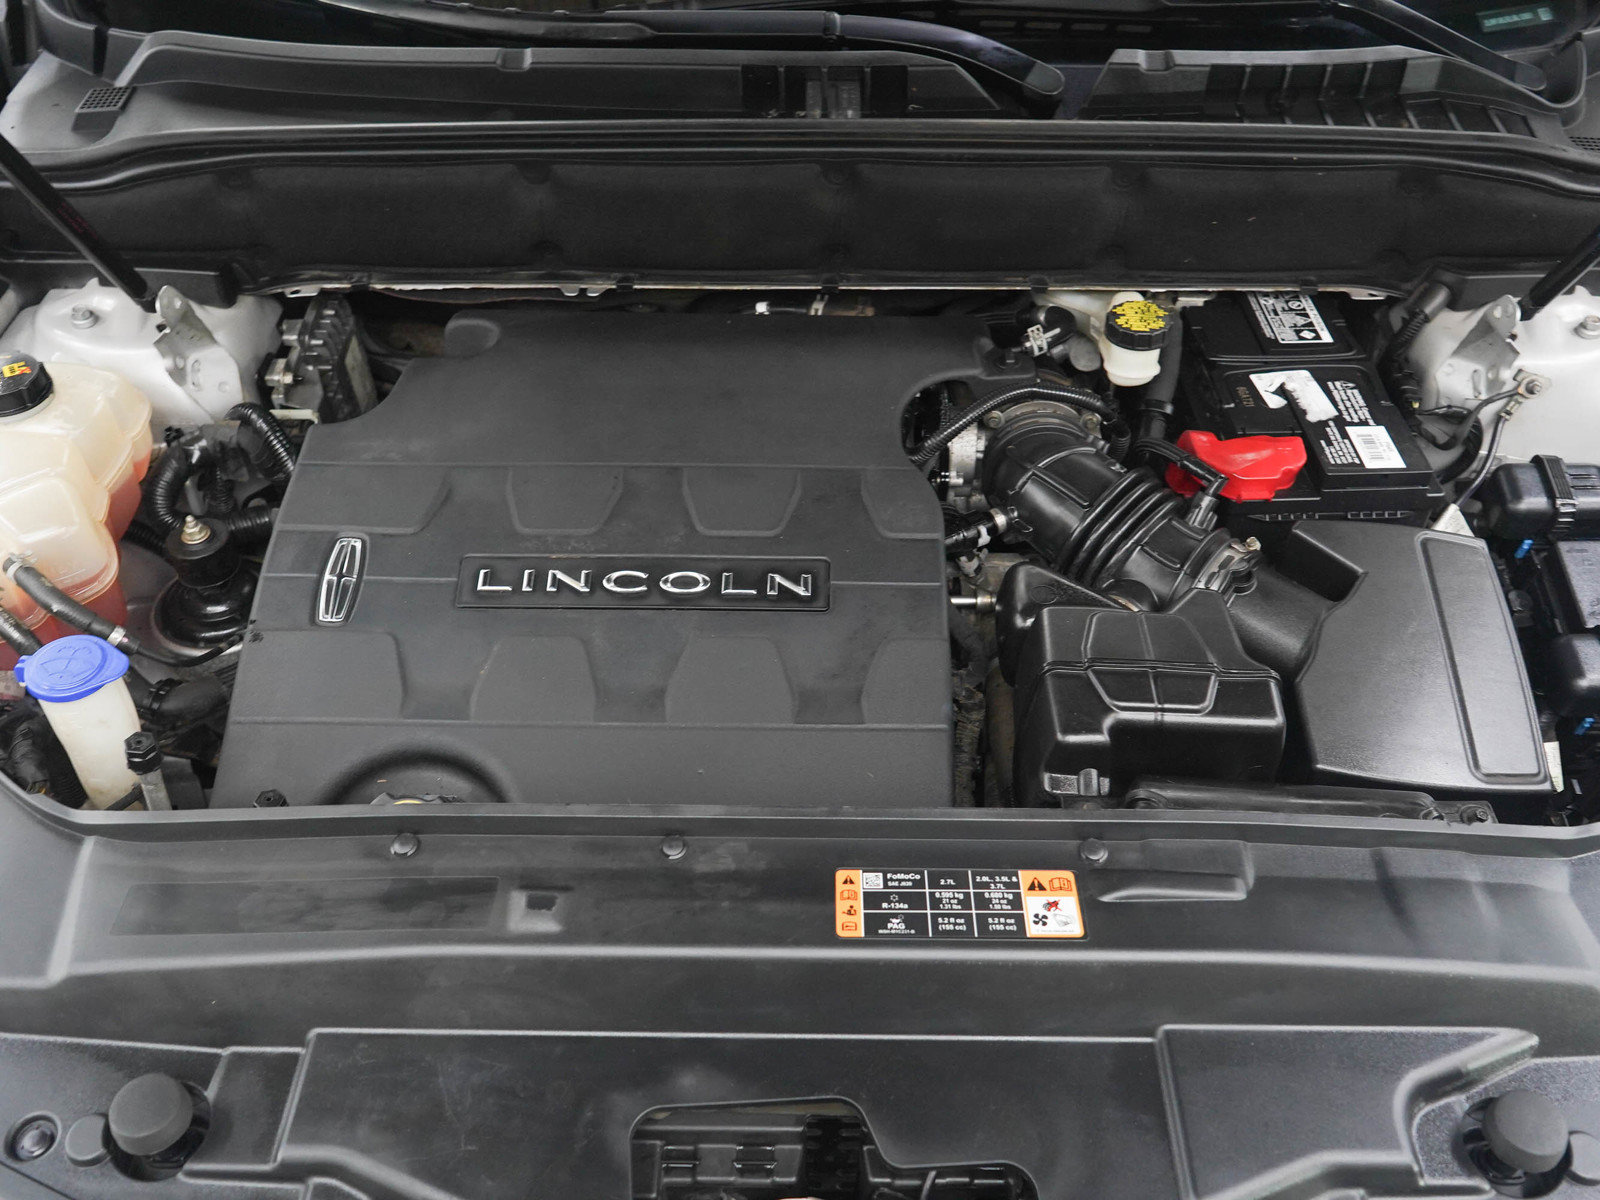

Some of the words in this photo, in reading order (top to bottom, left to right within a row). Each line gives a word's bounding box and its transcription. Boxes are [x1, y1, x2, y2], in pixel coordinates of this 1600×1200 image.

[477, 569, 812, 596] LINCOLN
[954, 892, 964, 900] kg
[1004, 892, 1013, 900] kg
